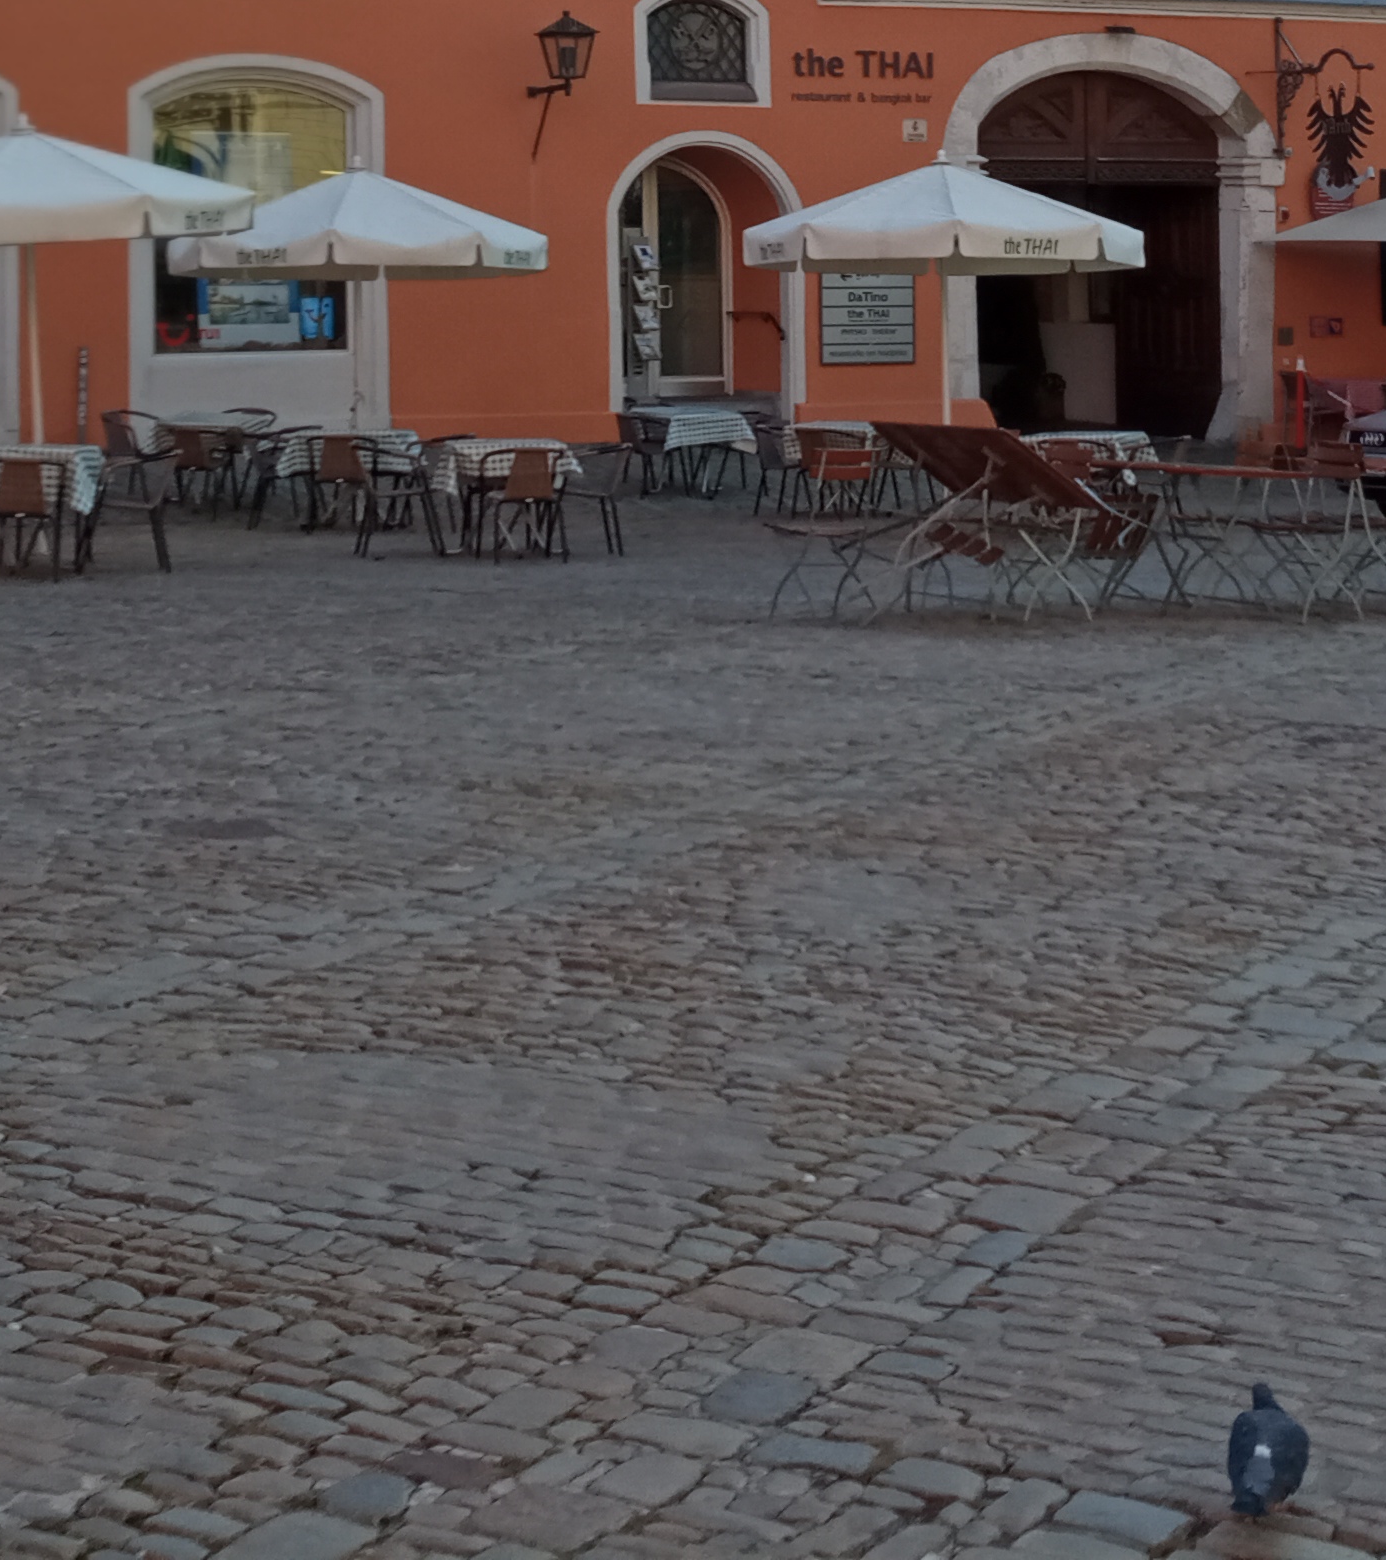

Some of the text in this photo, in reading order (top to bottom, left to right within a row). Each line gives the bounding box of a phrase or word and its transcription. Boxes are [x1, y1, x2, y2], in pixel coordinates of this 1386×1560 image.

[792, 48, 934, 79] the THAI
[1004, 237, 1059, 255] the THAI
[848, 291, 888, 302] DaTino
[867, 309, 890, 318] THAI
